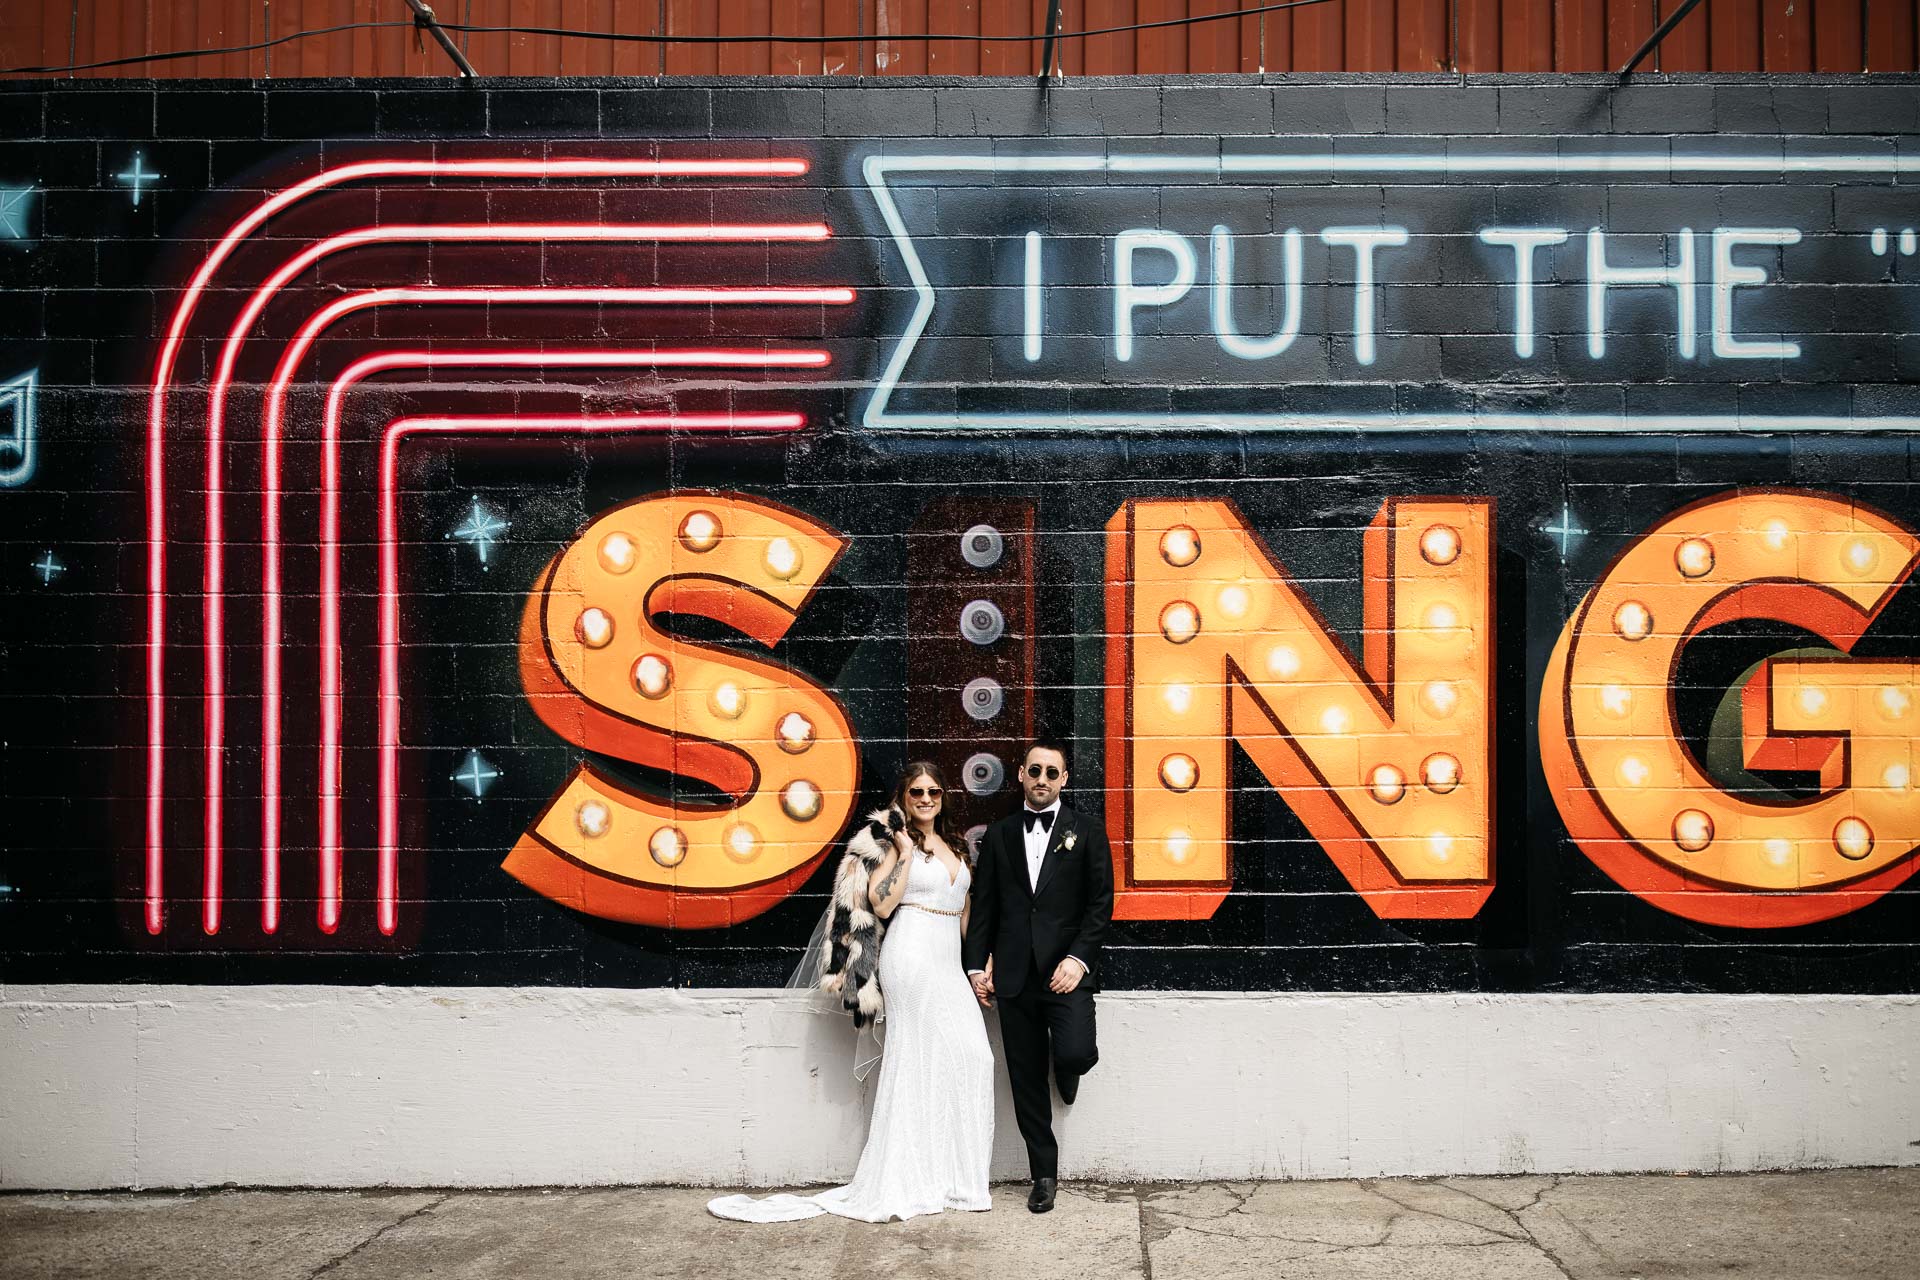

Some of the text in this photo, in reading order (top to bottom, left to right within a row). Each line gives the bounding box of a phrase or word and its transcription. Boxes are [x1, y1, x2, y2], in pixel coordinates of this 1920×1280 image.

[1024, 225, 1803, 365] I PUT THE
